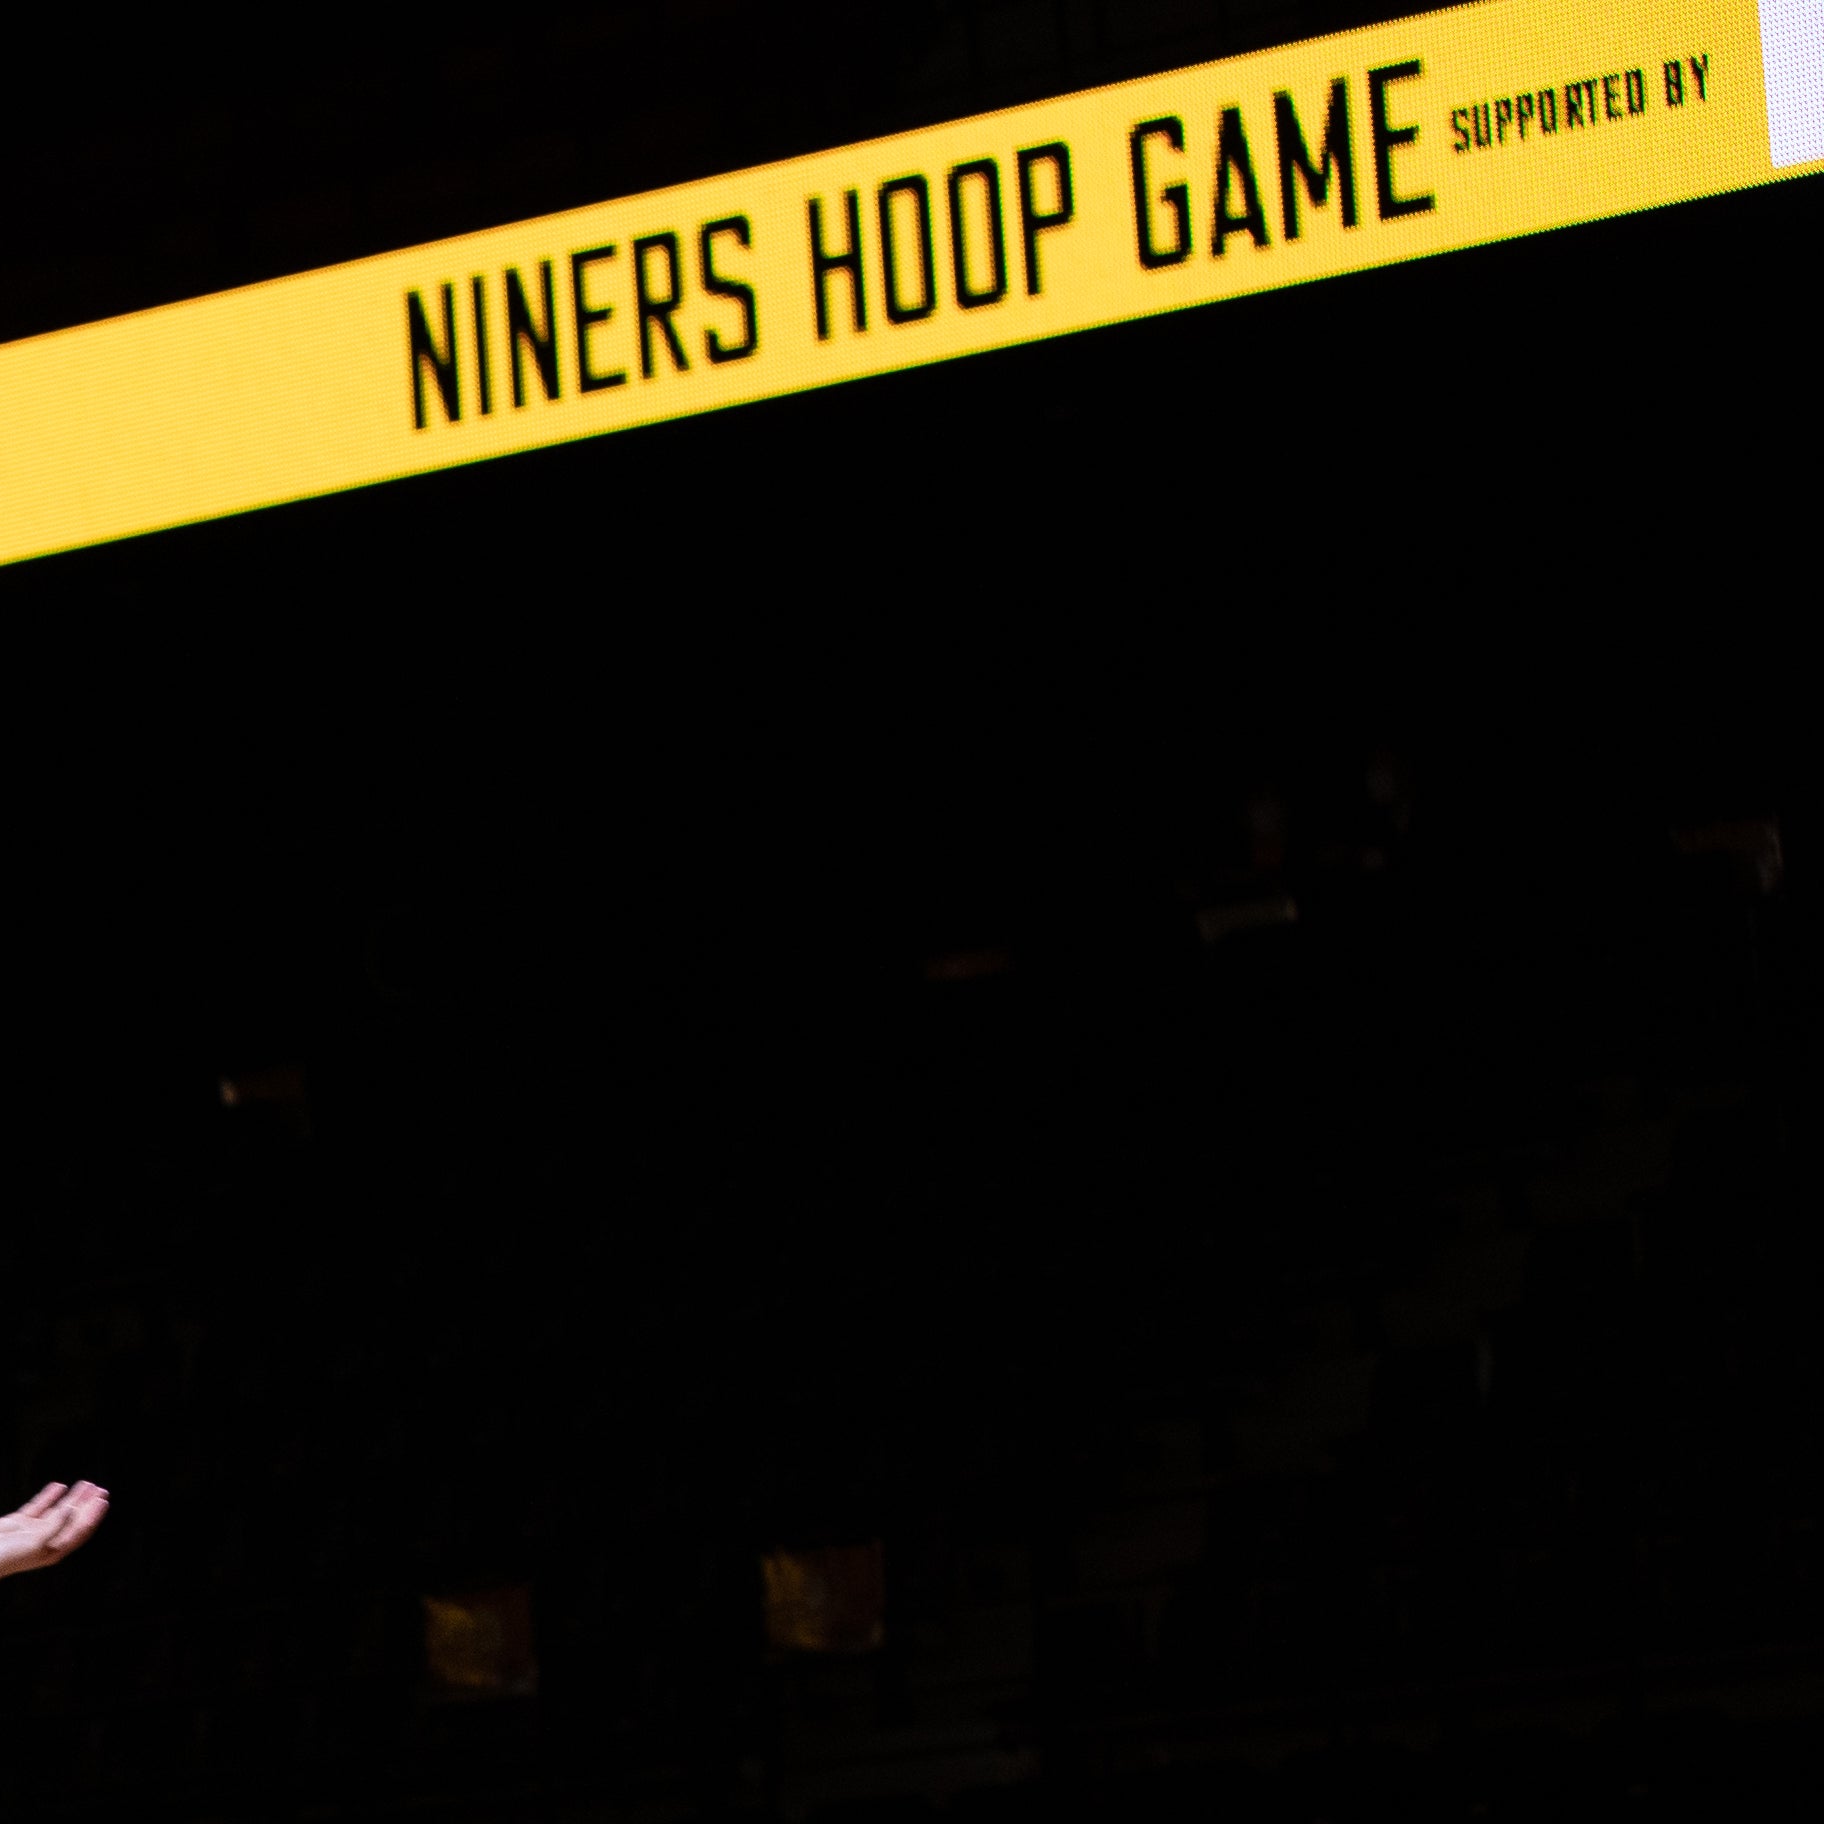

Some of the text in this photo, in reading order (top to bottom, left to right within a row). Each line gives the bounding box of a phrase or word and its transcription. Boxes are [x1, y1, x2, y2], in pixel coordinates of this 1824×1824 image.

[1449, 52, 1713, 154] SUPPORTED BY
[407, 57, 1438, 432] NINERS HOOP GAME
